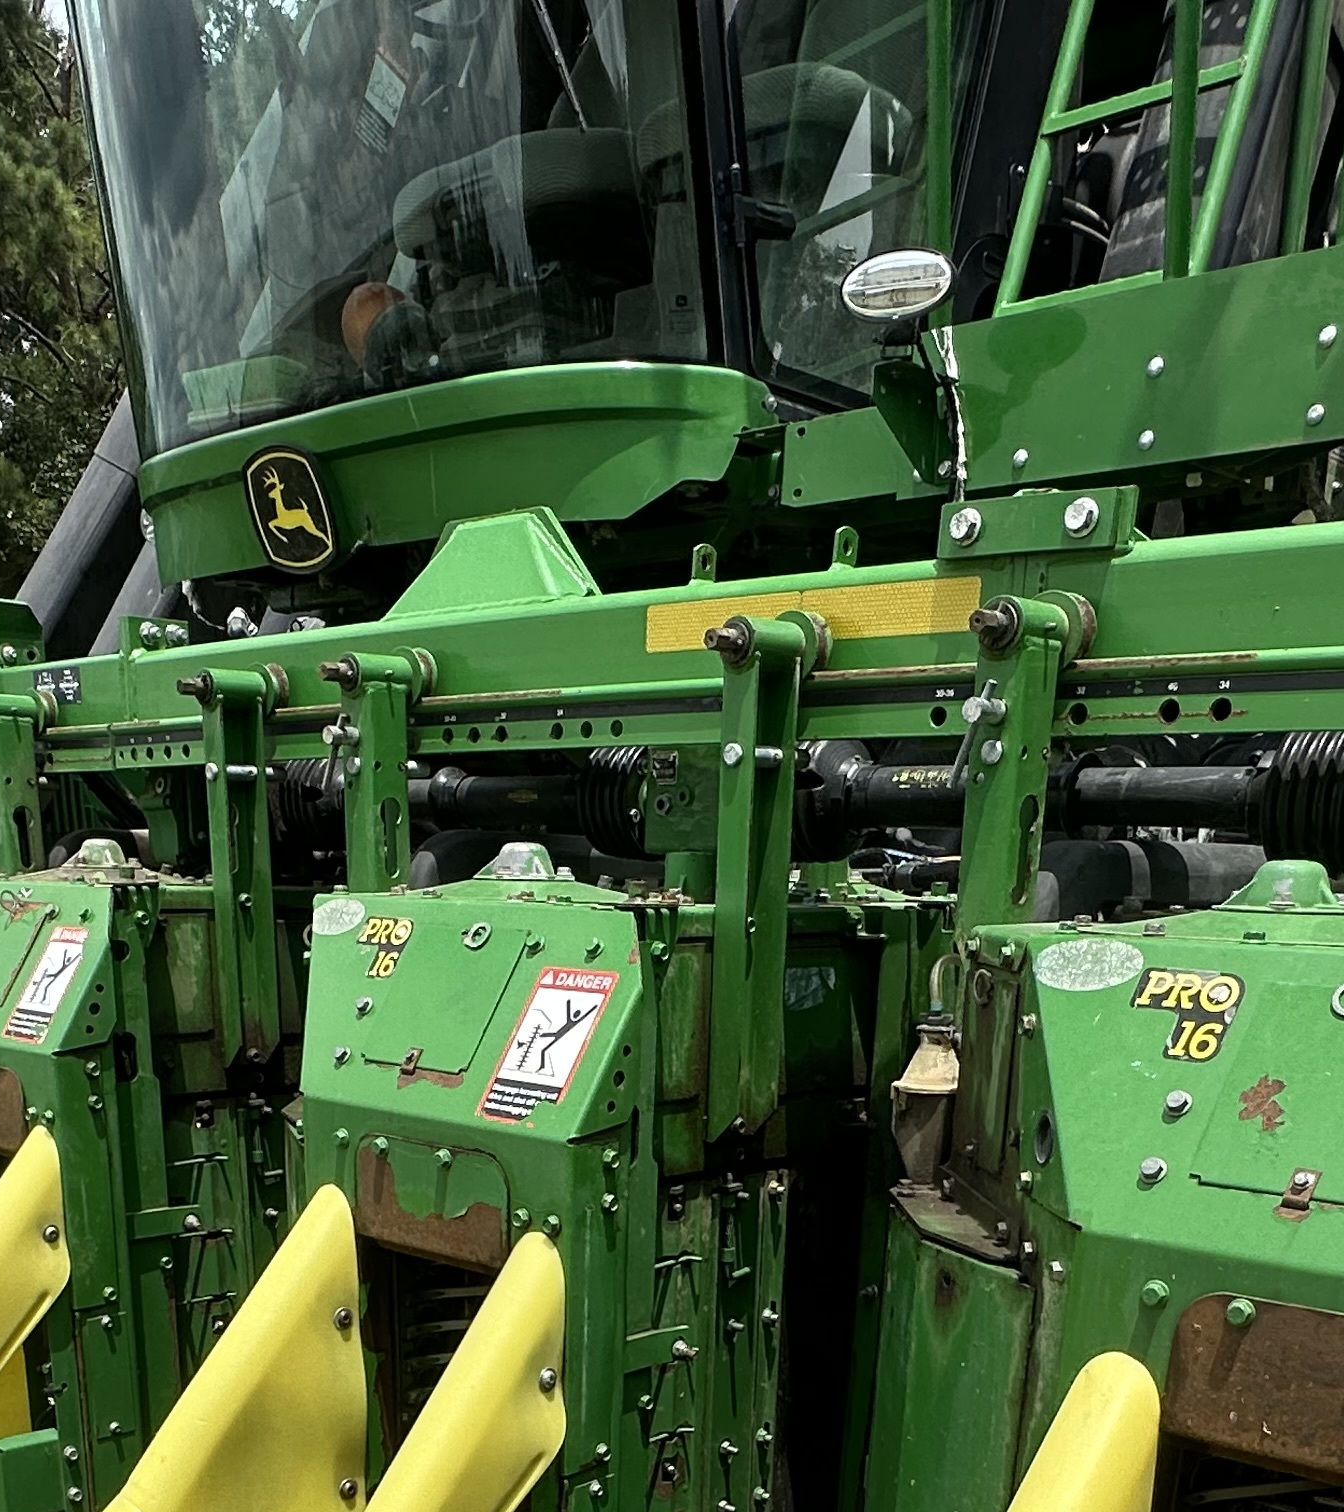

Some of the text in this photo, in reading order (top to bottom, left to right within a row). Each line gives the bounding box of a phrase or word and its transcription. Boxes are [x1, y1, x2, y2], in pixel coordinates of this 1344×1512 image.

[358, 918, 413, 946] PRO
[368, 951, 400, 977] 16
[555, 972, 613, 990] DANGER
[1135, 970, 1240, 1013] PRO
[1167, 1020, 1224, 1060] 16
